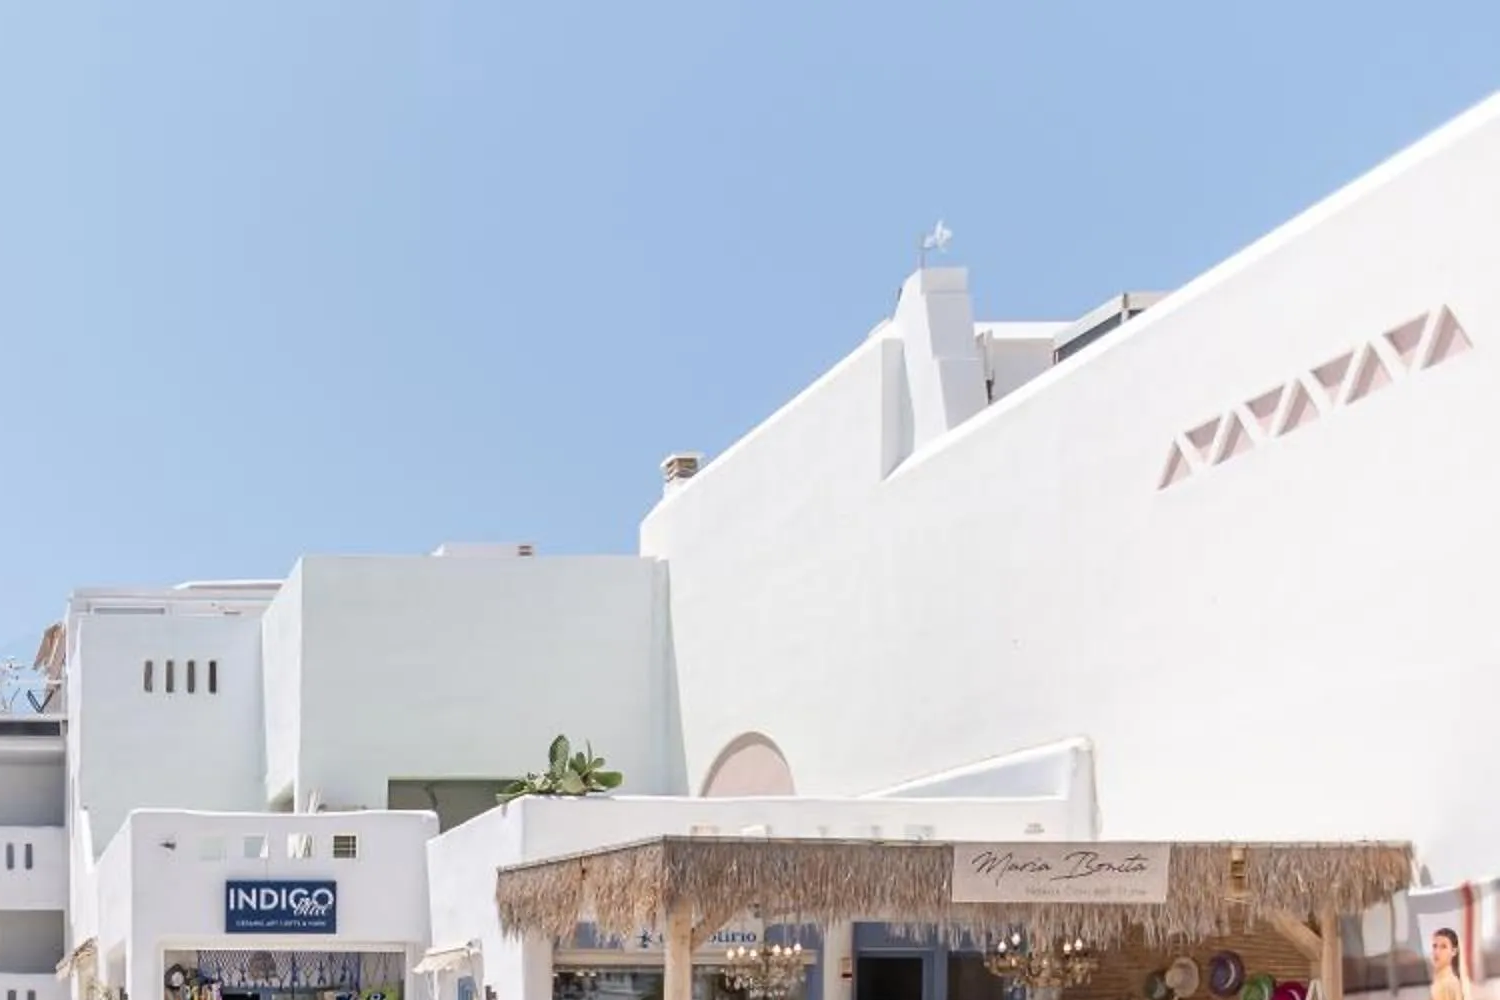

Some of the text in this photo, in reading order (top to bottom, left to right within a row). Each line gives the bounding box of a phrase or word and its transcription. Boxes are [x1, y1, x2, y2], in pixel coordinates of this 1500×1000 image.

[972, 850, 1149, 886] Maria Bonita
[229, 887, 334, 910] INDIGO
